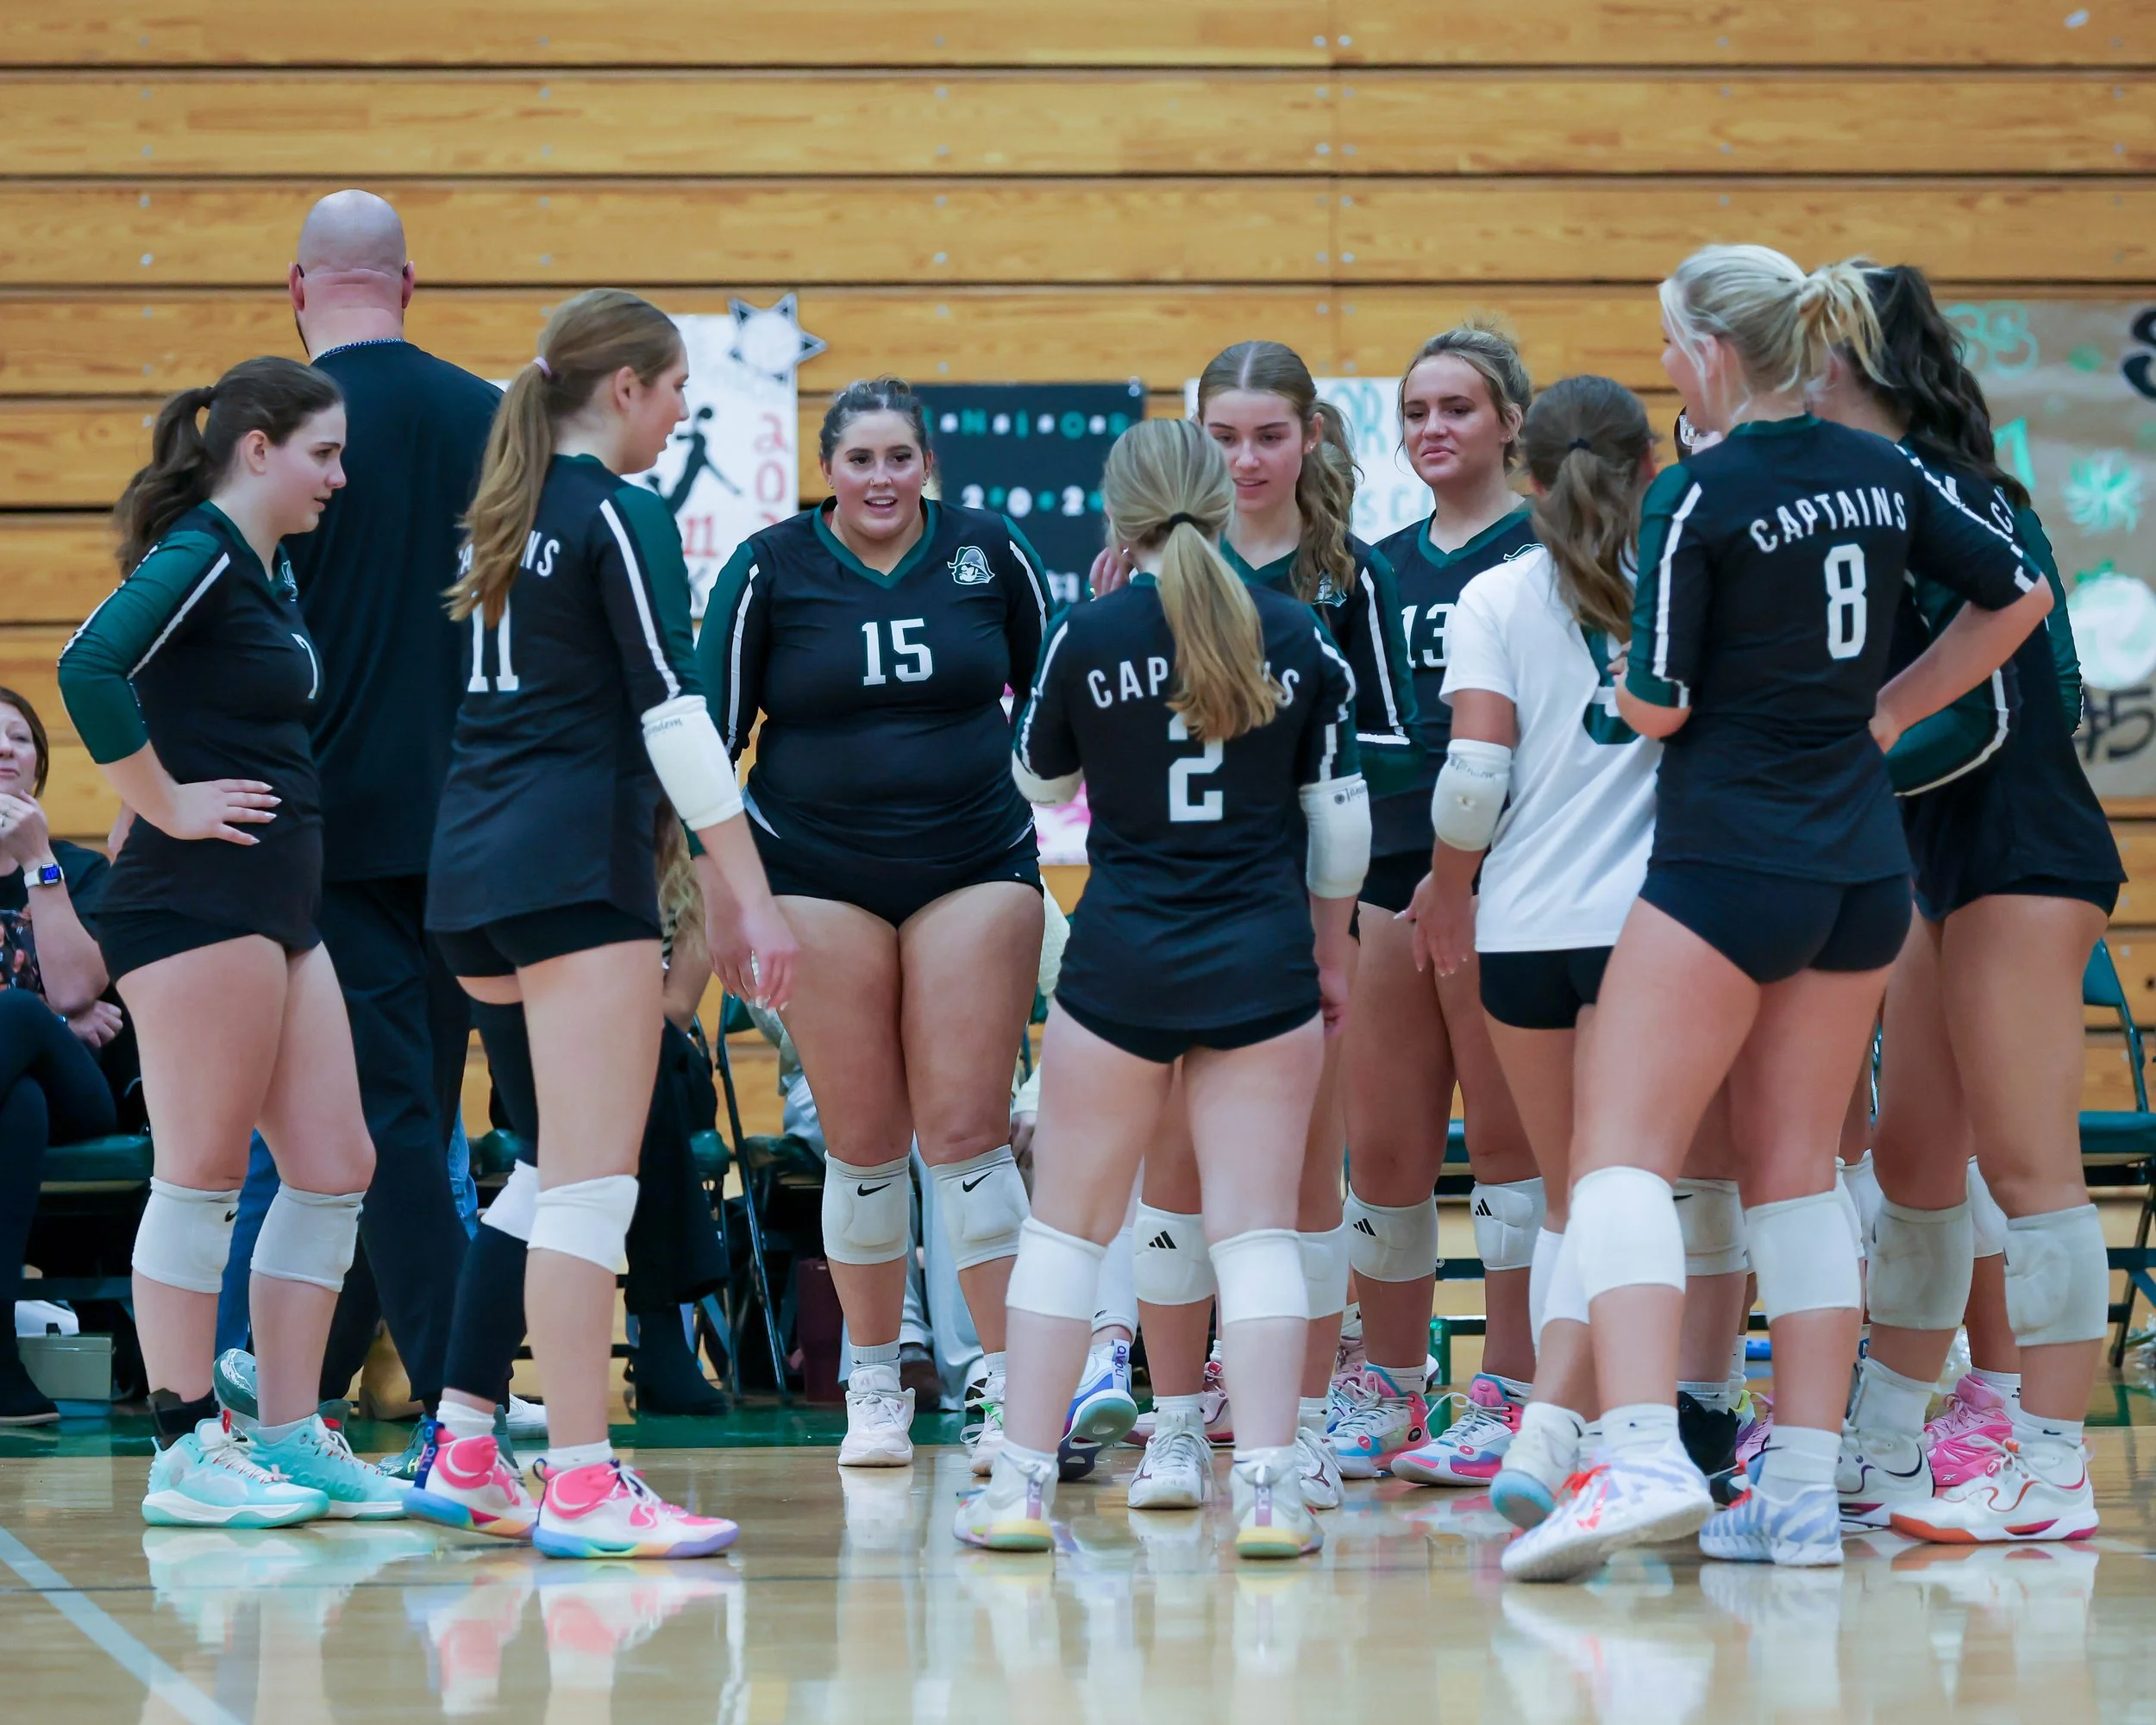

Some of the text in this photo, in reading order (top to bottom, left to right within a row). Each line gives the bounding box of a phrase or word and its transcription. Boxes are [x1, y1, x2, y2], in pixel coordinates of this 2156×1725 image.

[1749, 486, 1907, 553] CAPTAINS
[1823, 543, 1867, 659] 8
[862, 618, 933, 686] 15
[1401, 603, 1458, 668] 13
[1087, 656, 1300, 709] CAPS
[1169, 713, 1223, 822] 2
